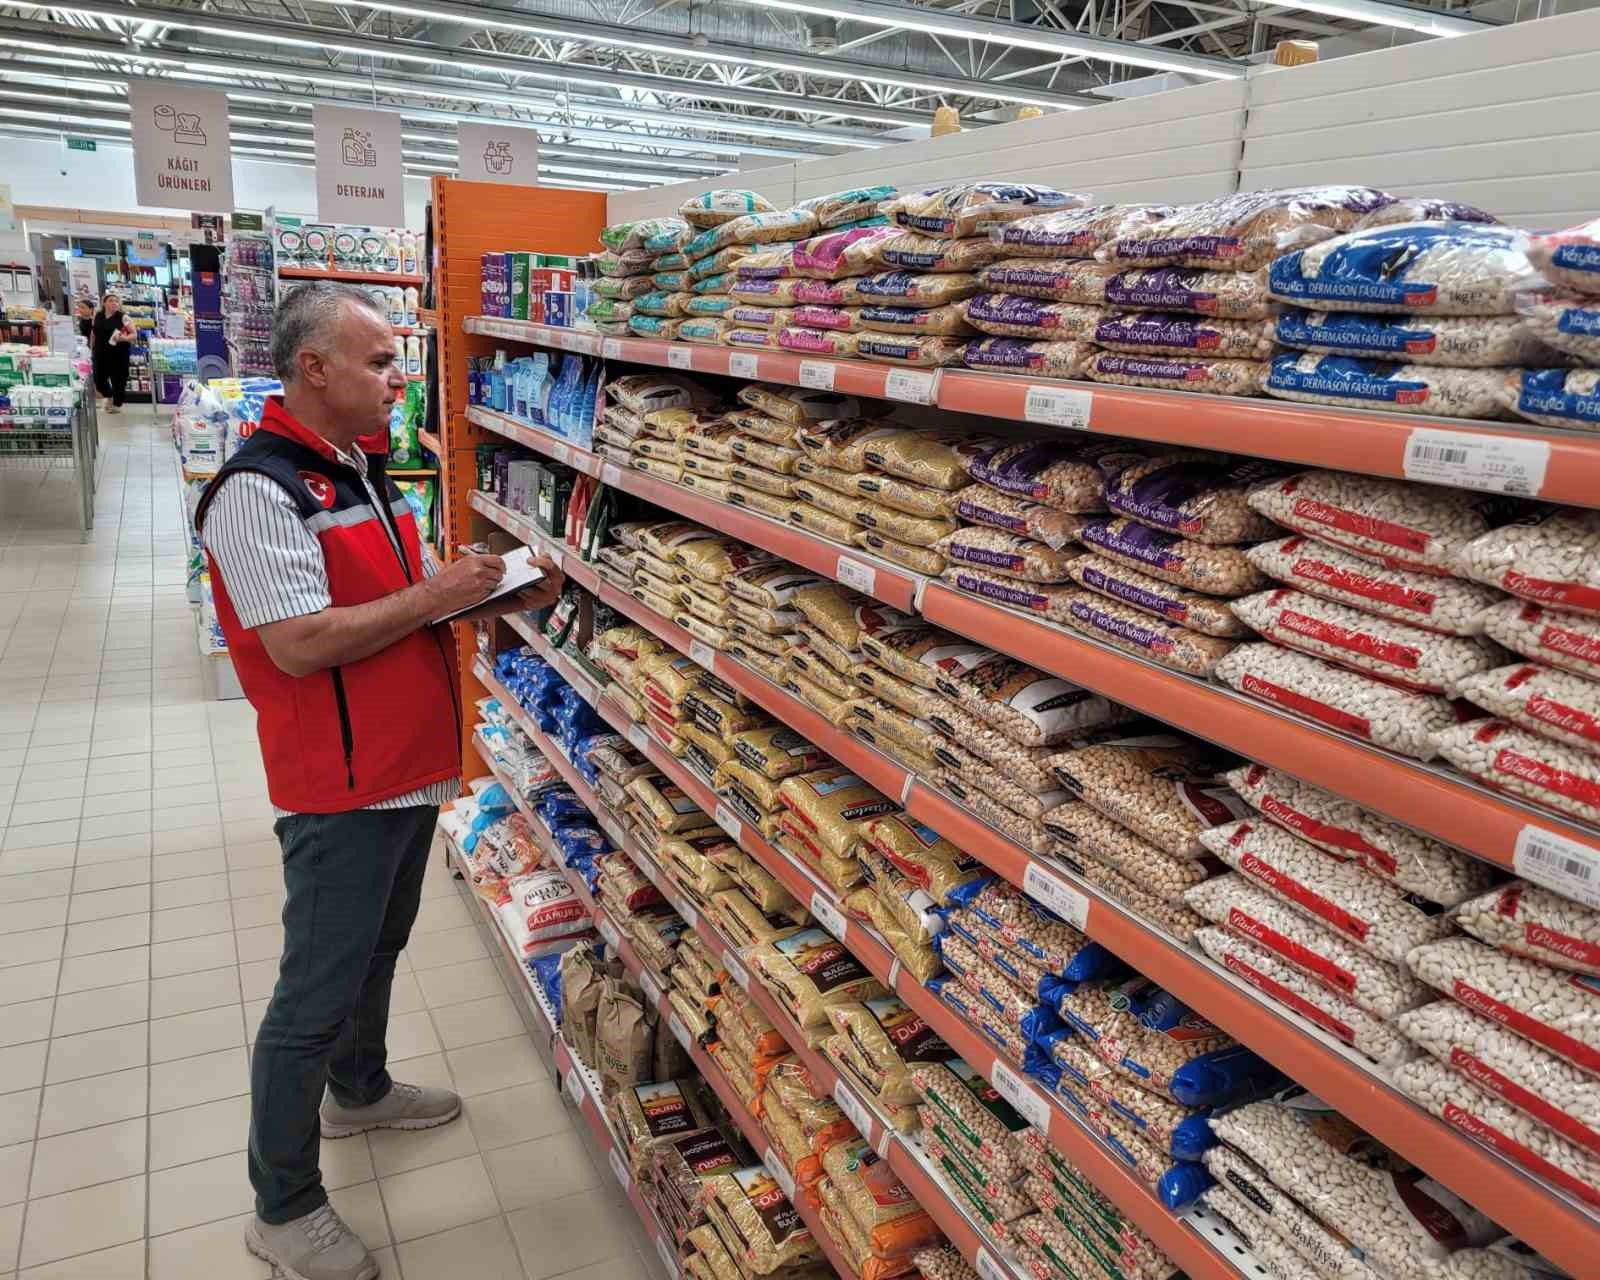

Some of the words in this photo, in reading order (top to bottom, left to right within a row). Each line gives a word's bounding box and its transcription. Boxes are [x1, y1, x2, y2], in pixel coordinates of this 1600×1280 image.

[158, 174, 211, 193] ÜRÜNLERİ
[336, 184, 385, 200] DETERJAN
[1308, 283, 1358, 297] DERMASON
[1359, 285, 1398, 299] FASULYE
[1302, 376, 1350, 393] DERMASON
[1350, 381, 1389, 396] FASULYE
